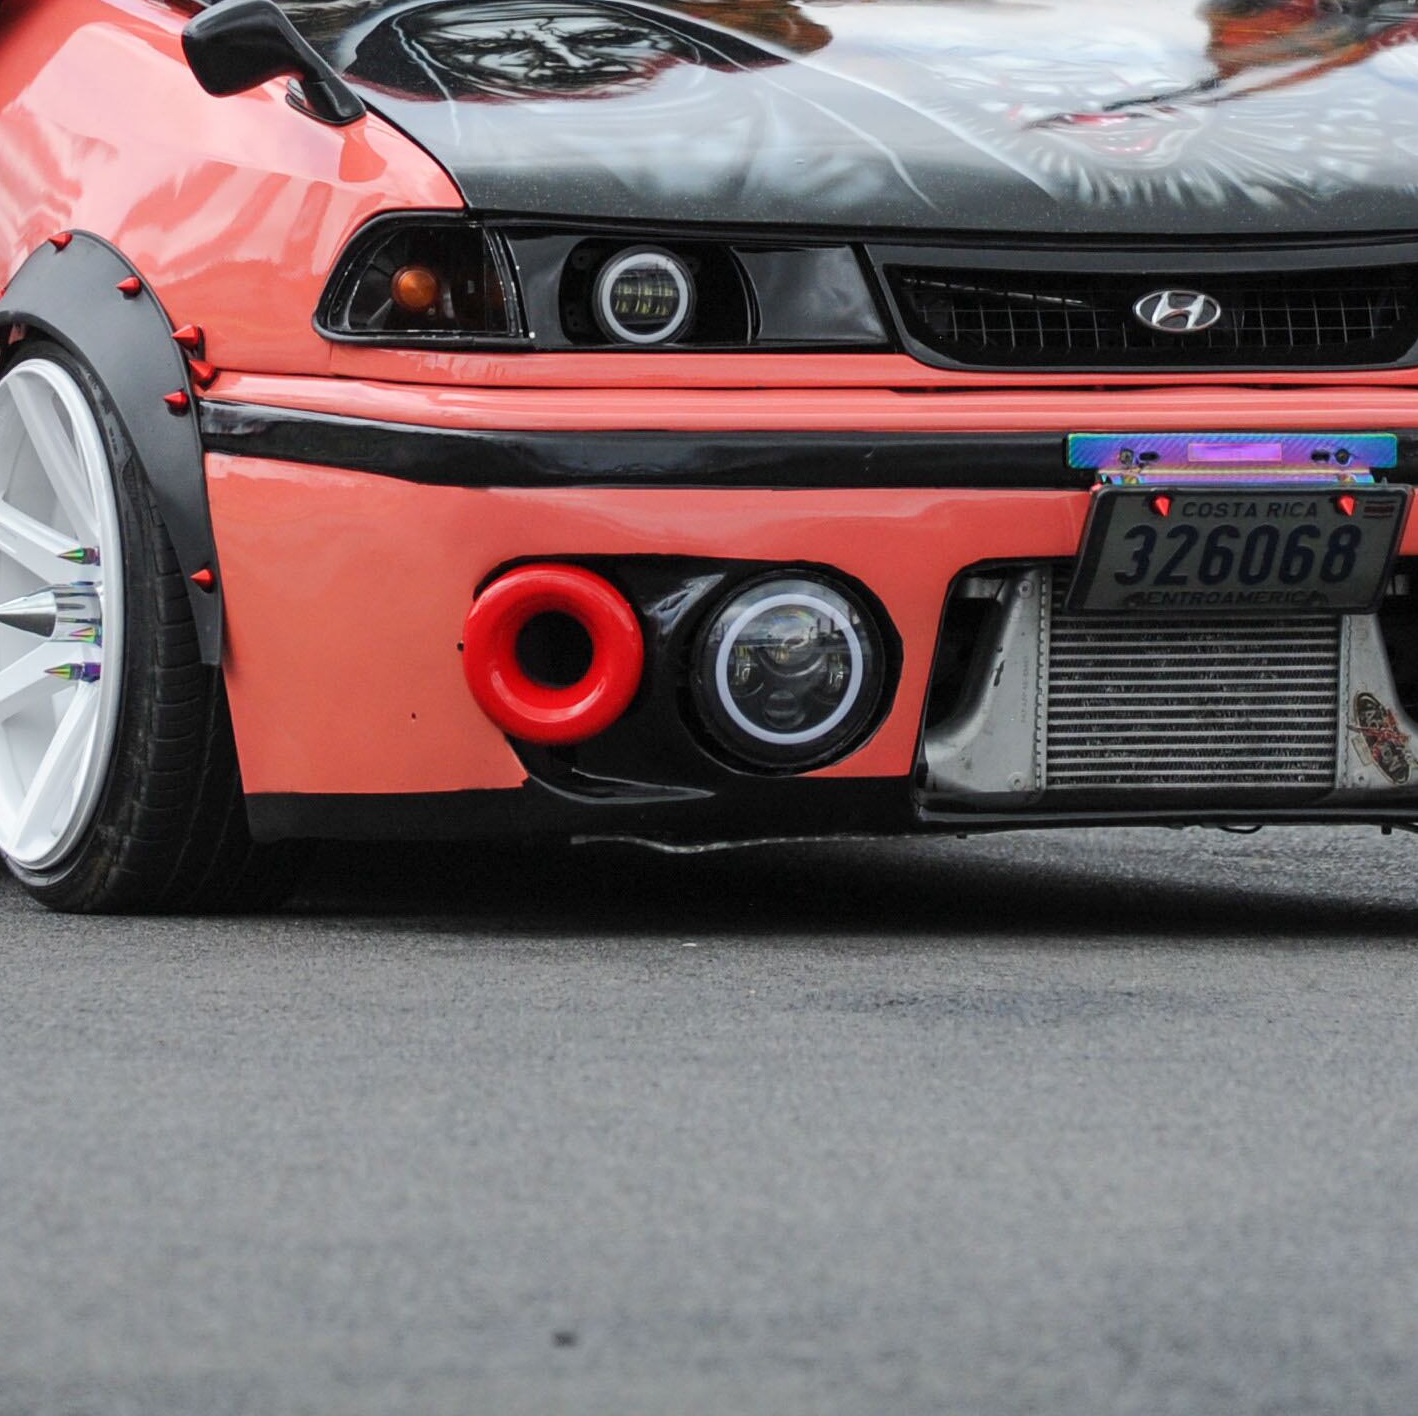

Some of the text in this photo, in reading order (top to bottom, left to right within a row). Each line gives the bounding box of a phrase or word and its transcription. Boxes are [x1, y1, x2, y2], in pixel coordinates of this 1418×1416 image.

[1182, 501, 1319, 518] COSTA RICA
[1114, 524, 1362, 586] 326068
